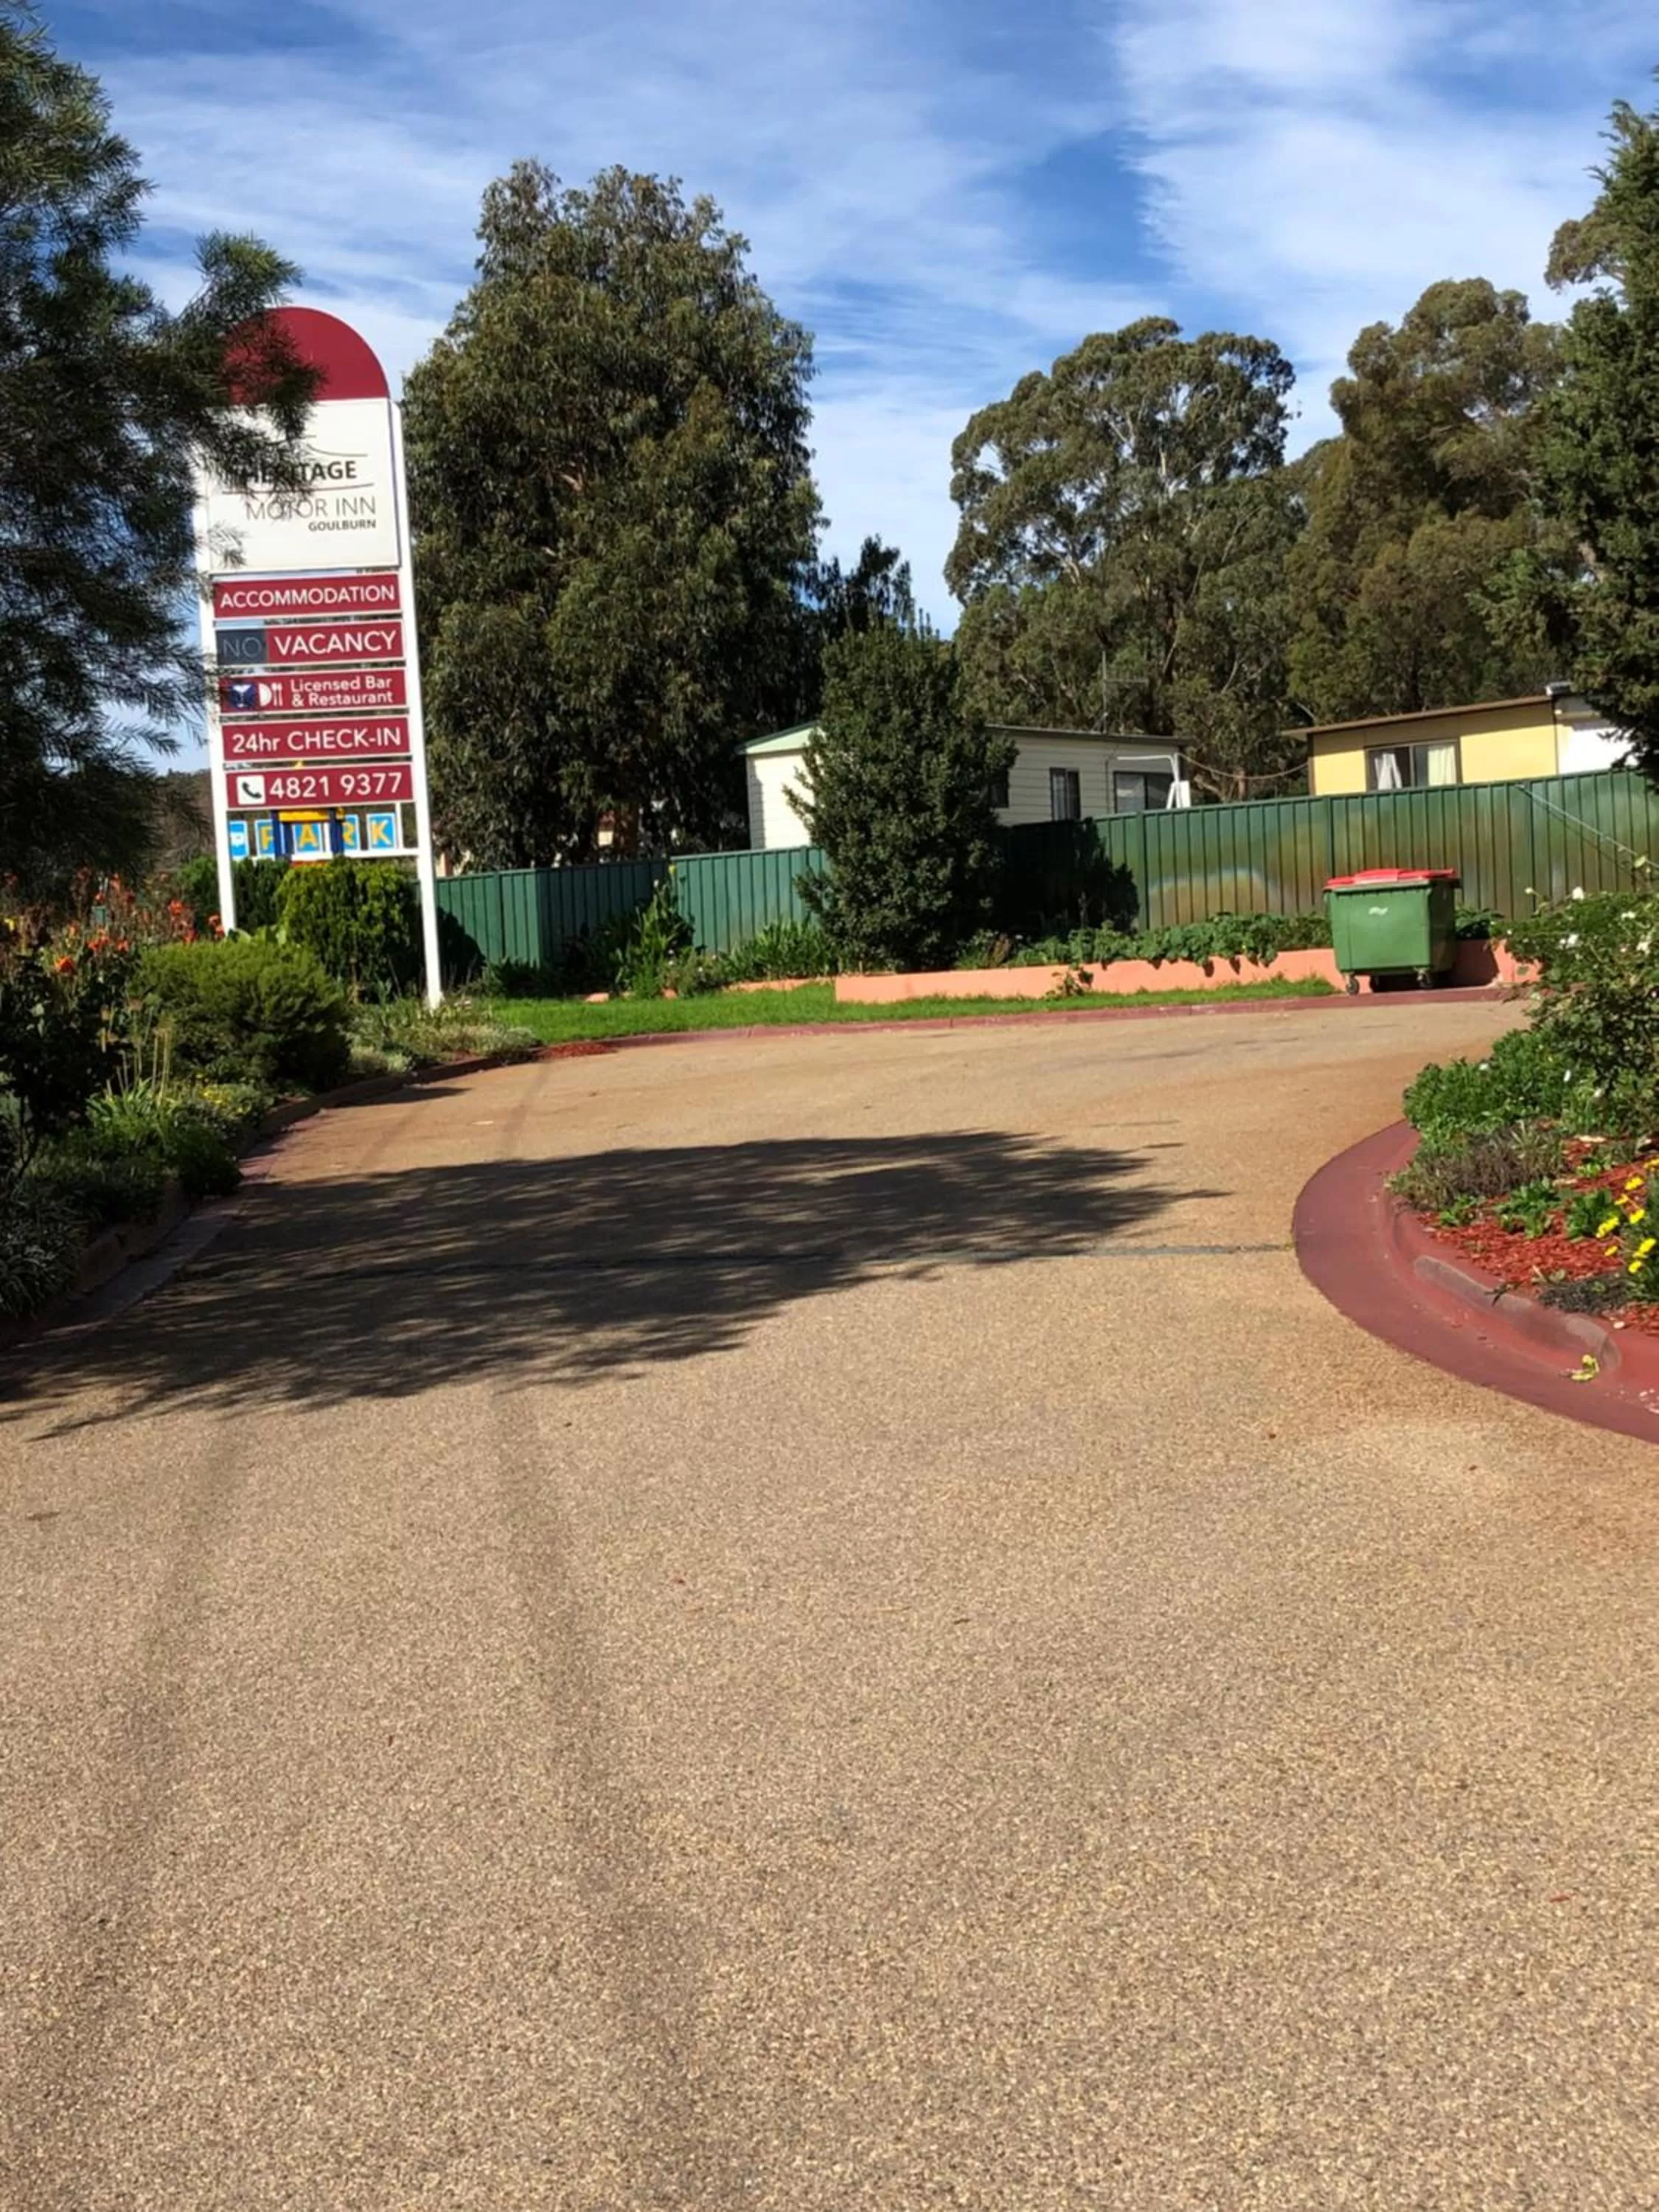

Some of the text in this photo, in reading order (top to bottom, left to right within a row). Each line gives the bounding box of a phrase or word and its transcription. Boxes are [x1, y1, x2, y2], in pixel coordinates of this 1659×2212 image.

[246, 495, 377, 520] MOTOR INN
[308, 518, 377, 532] GOULBURN
[220, 585, 395, 608] ACCOMMODATION
[223, 630, 397, 658] NO VACANCY
[291, 675, 392, 692] Licensed Bar
[291, 690, 393, 707] & Restaurant
[232, 726, 402, 754] 24hr CHECK-IN
[269, 772, 403, 799] 4821 9377
